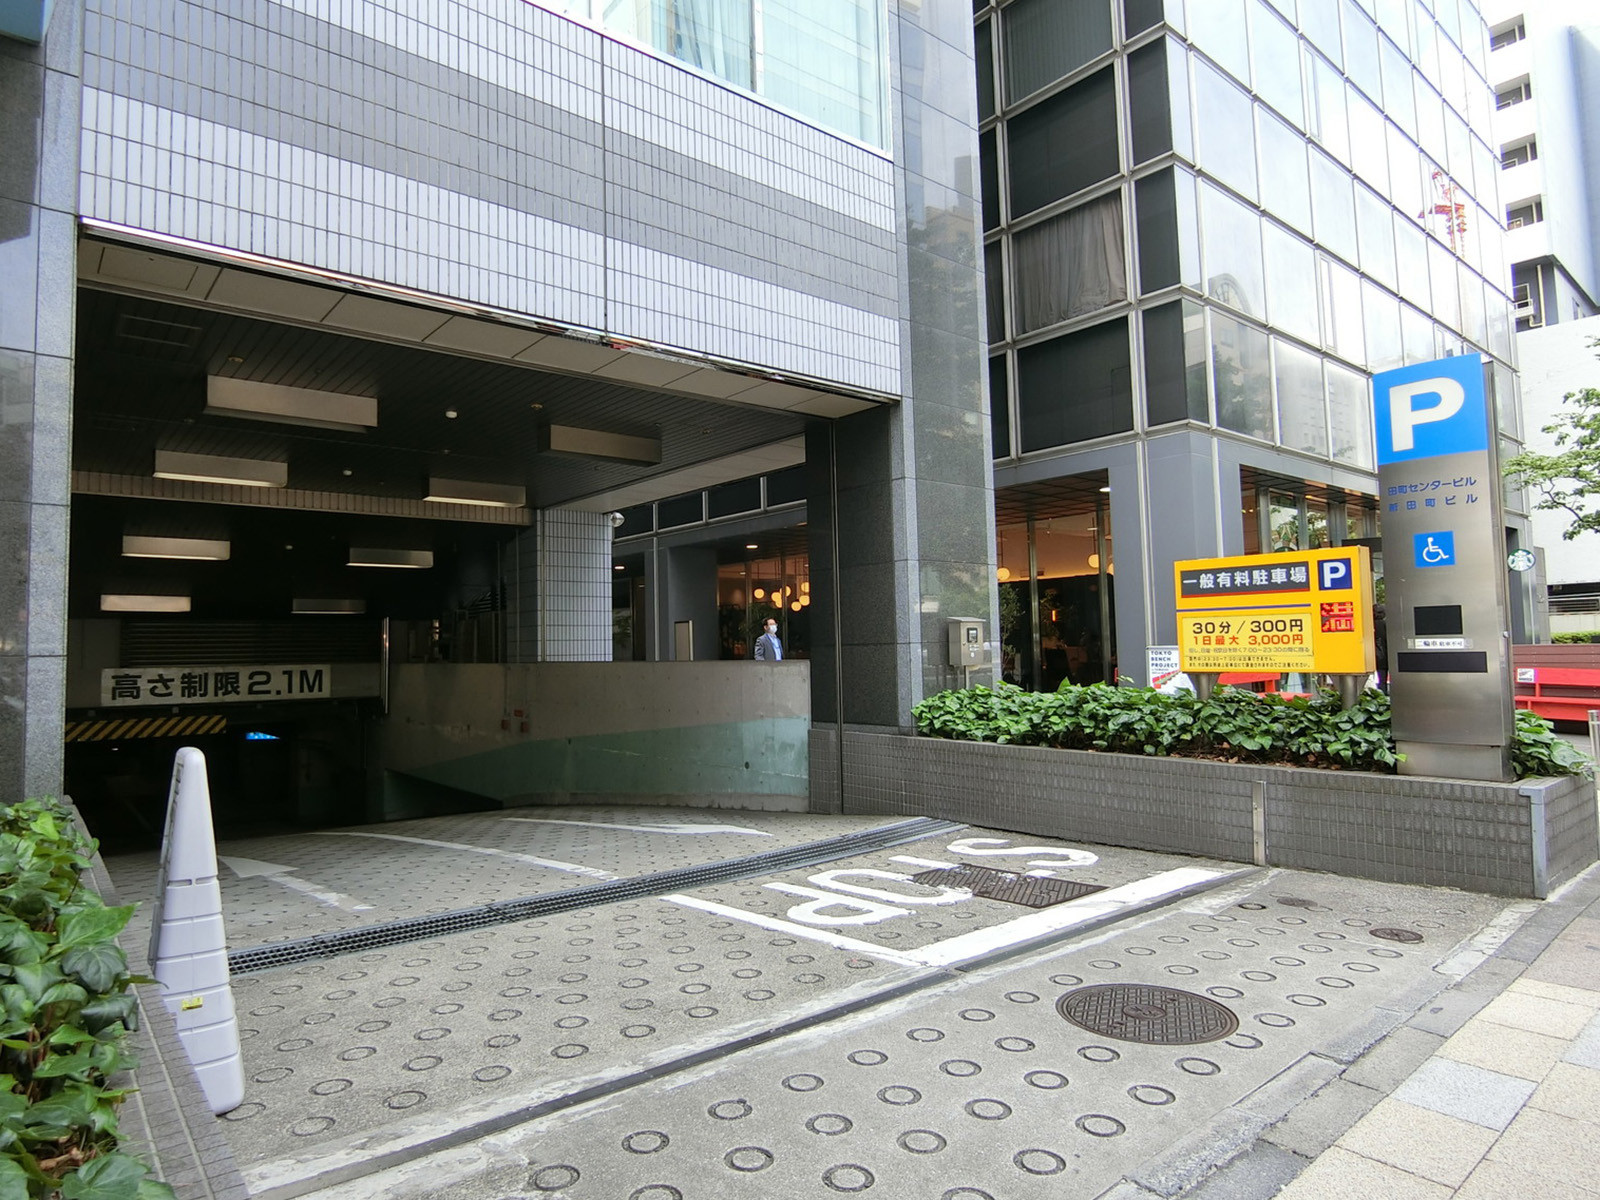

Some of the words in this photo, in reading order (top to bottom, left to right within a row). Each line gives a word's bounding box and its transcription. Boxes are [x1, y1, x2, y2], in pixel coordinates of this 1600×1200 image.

[1389, 377, 1465, 452] P
[1388, 477, 1477, 496] 田町センタービル
[1183, 566, 1308, 589] 一般有料駐車場
[1323, 561, 1346, 588] P
[1193, 635, 1239, 646] 1日最大
[1248, 634, 1304, 646] 3,000円
[111, 669, 323, 700] 高さ制限2.1M
